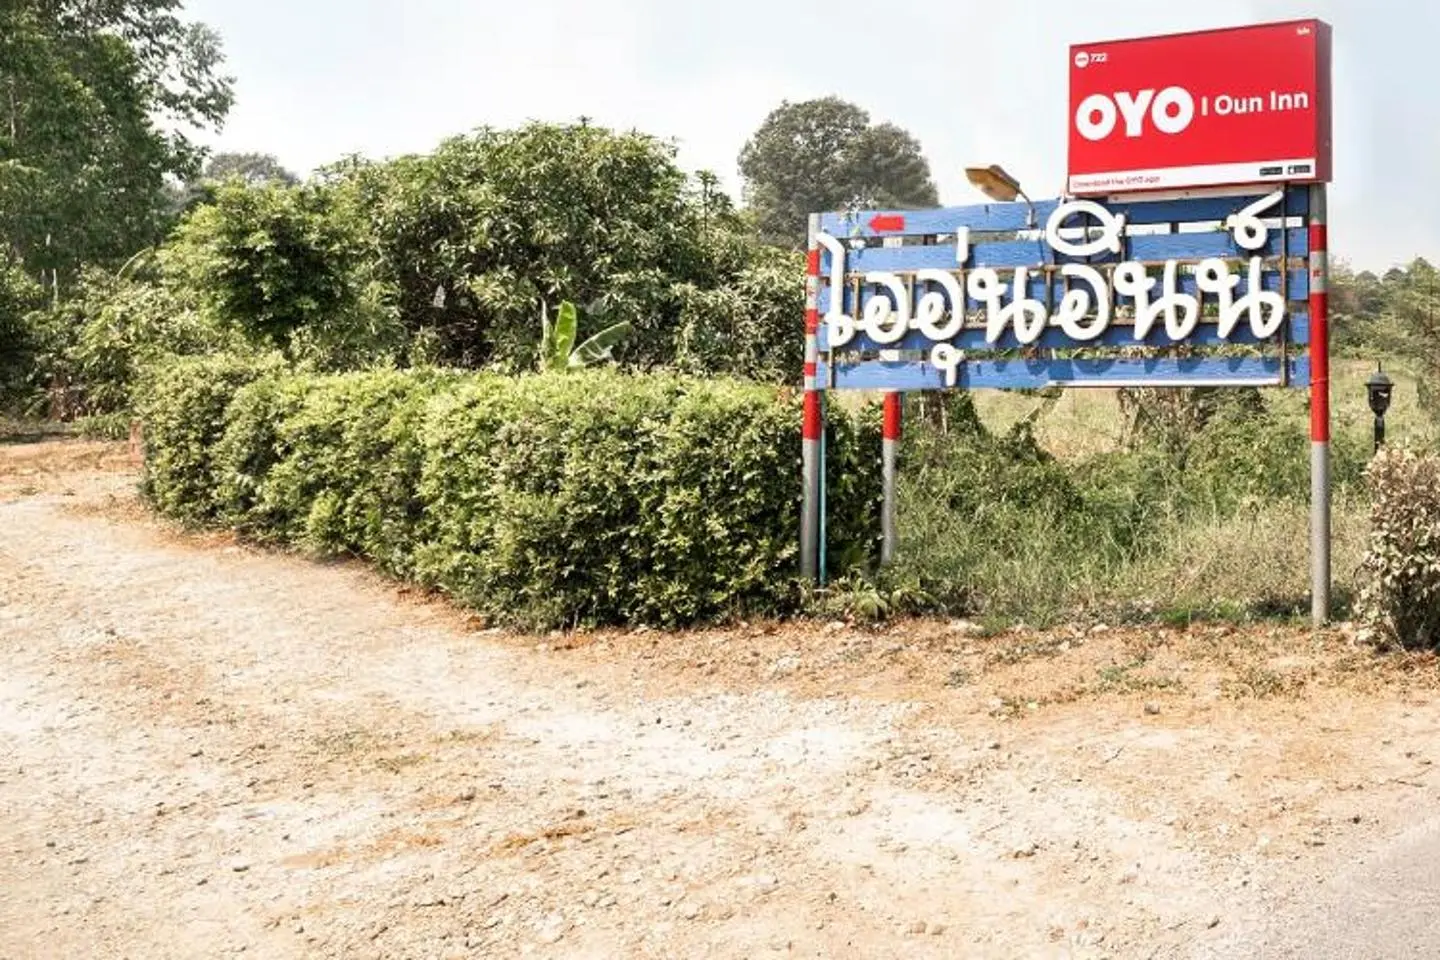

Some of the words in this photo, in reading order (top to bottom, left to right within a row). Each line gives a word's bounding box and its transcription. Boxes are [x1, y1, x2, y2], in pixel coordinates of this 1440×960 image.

[1075, 86, 1194, 141] OYO
[1214, 94, 1263, 115] Oun
[1270, 91, 1309, 111] Inn
